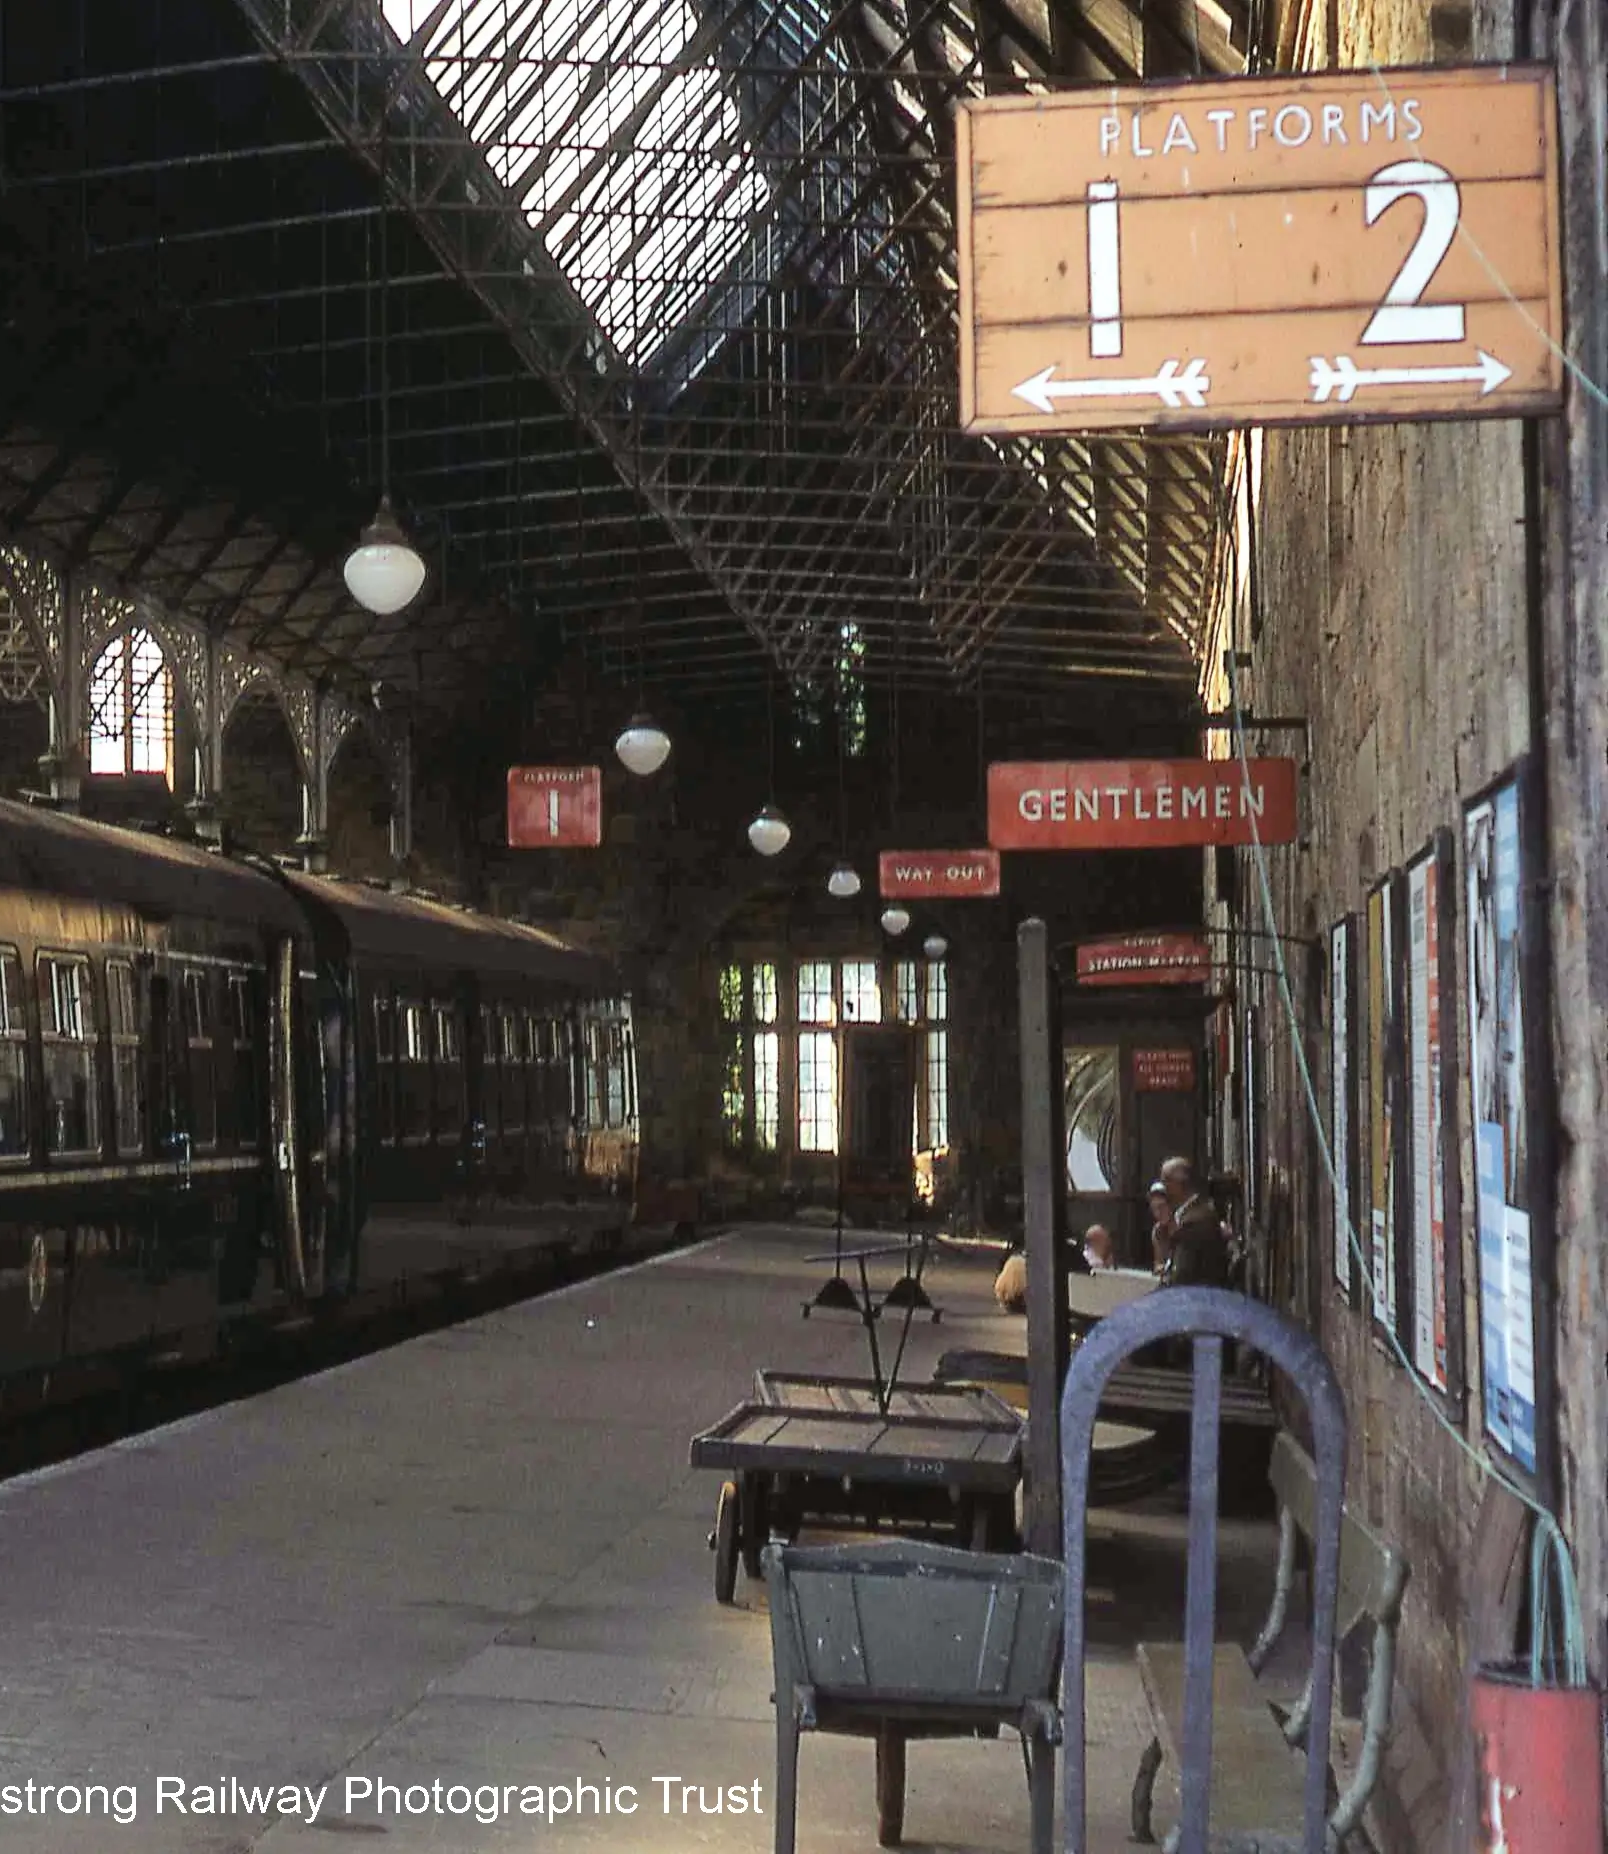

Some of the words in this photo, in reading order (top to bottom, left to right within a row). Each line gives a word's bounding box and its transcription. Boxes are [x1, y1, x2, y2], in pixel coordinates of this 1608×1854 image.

[1099, 100, 1424, 157] PLATFORMS
[1088, 179, 1123, 357] 1
[1358, 159, 1466, 345] 2
[523, 770, 584, 783] PLATFORM
[1018, 785, 1266, 822] GENTLEMEN
[895, 866, 932, 882] WAY
[946, 865, 984, 881] OUT
